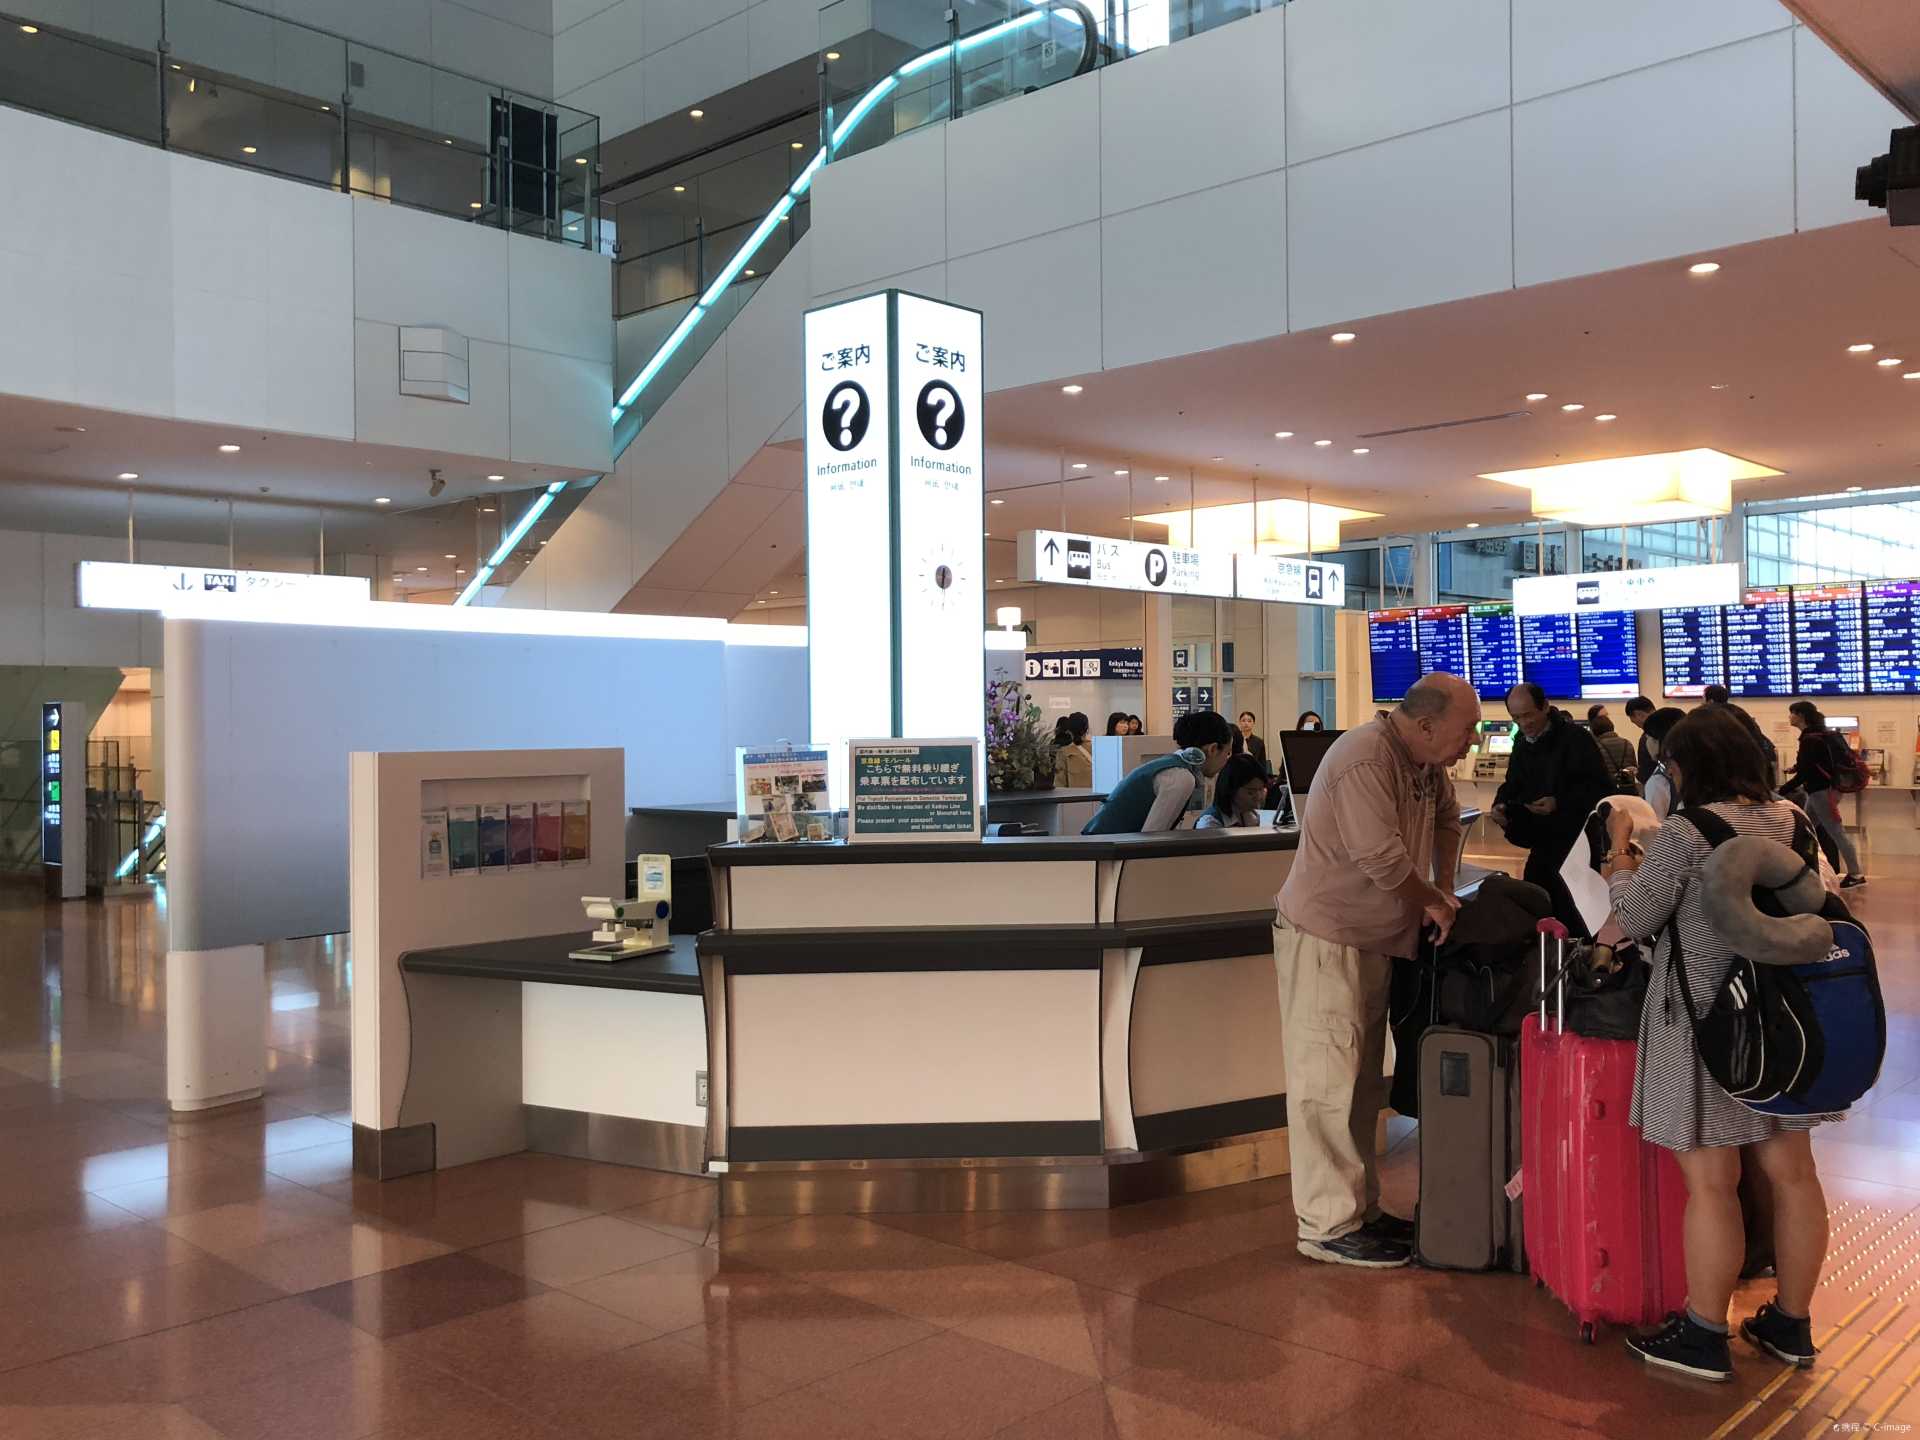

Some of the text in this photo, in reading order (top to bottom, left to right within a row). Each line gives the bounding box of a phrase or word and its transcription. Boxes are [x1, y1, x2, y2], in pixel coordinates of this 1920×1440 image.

[821, 344, 871, 372] ご案内
[915, 343, 966, 372] ご案内
[817, 457, 877, 476] Information
[910, 456, 972, 475] Information
[1097, 543, 1120, 556] バス
[1097, 559, 1112, 570] Bus
[206, 574, 236, 586] TAXI
[246, 576, 297, 588] タクシー
